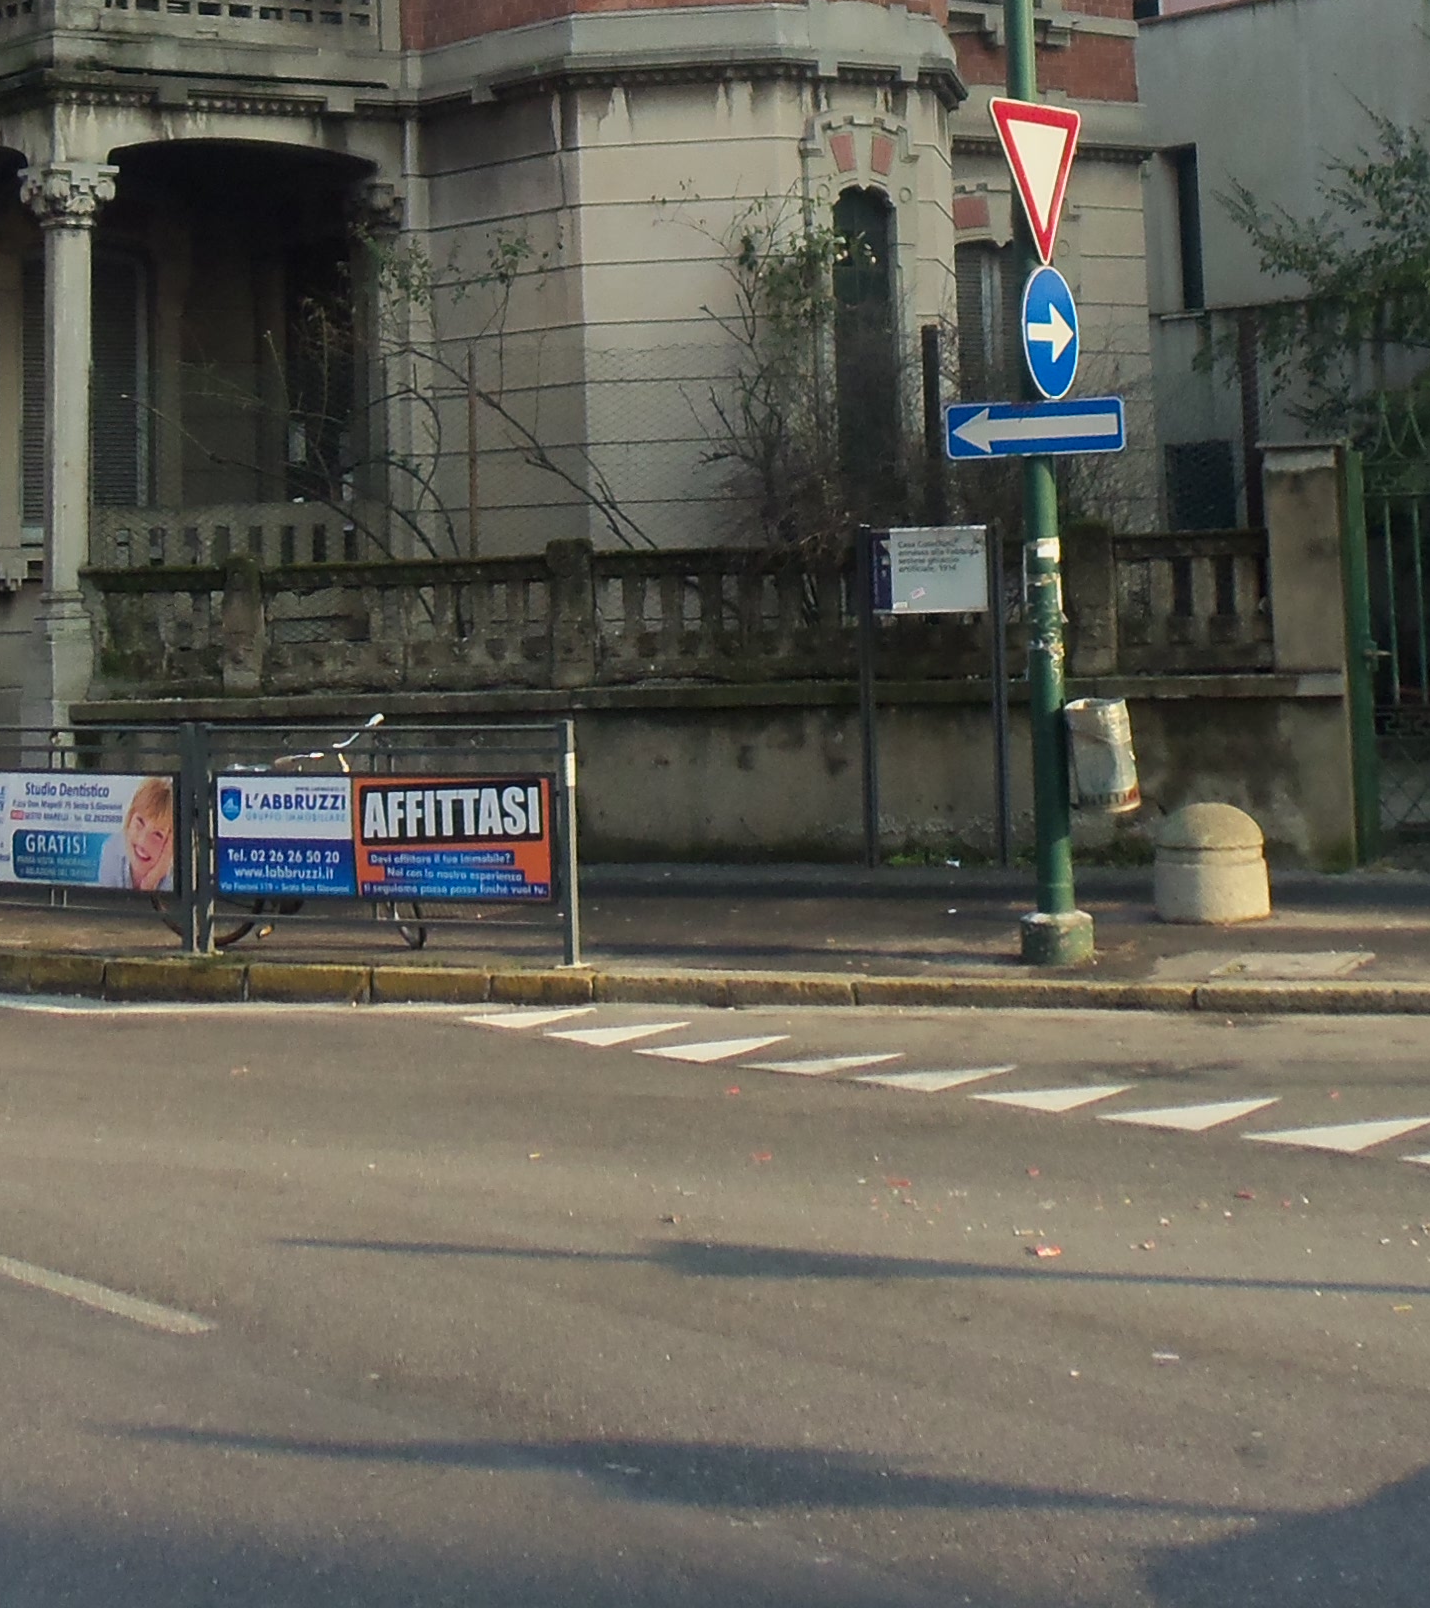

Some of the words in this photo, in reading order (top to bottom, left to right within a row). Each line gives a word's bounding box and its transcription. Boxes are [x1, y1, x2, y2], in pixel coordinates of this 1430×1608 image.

[25, 781, 57, 796] Studio
[59, 782, 110, 798] Dentistico
[245, 792, 346, 810] L'ABBRUZZI
[363, 786, 541, 839] AFFITTASI
[26, 834, 87, 854] GRATIS!
[227, 848, 247, 862] Tel.
[250, 850, 266, 862] 02
[269, 850, 284, 863] 26
[288, 850, 303, 863] 26
[306, 850, 321, 863] 50
[325, 851, 340, 864] 20
[371, 854, 391, 864] Devi
[234, 864, 334, 880] www.labbruzzi.it
